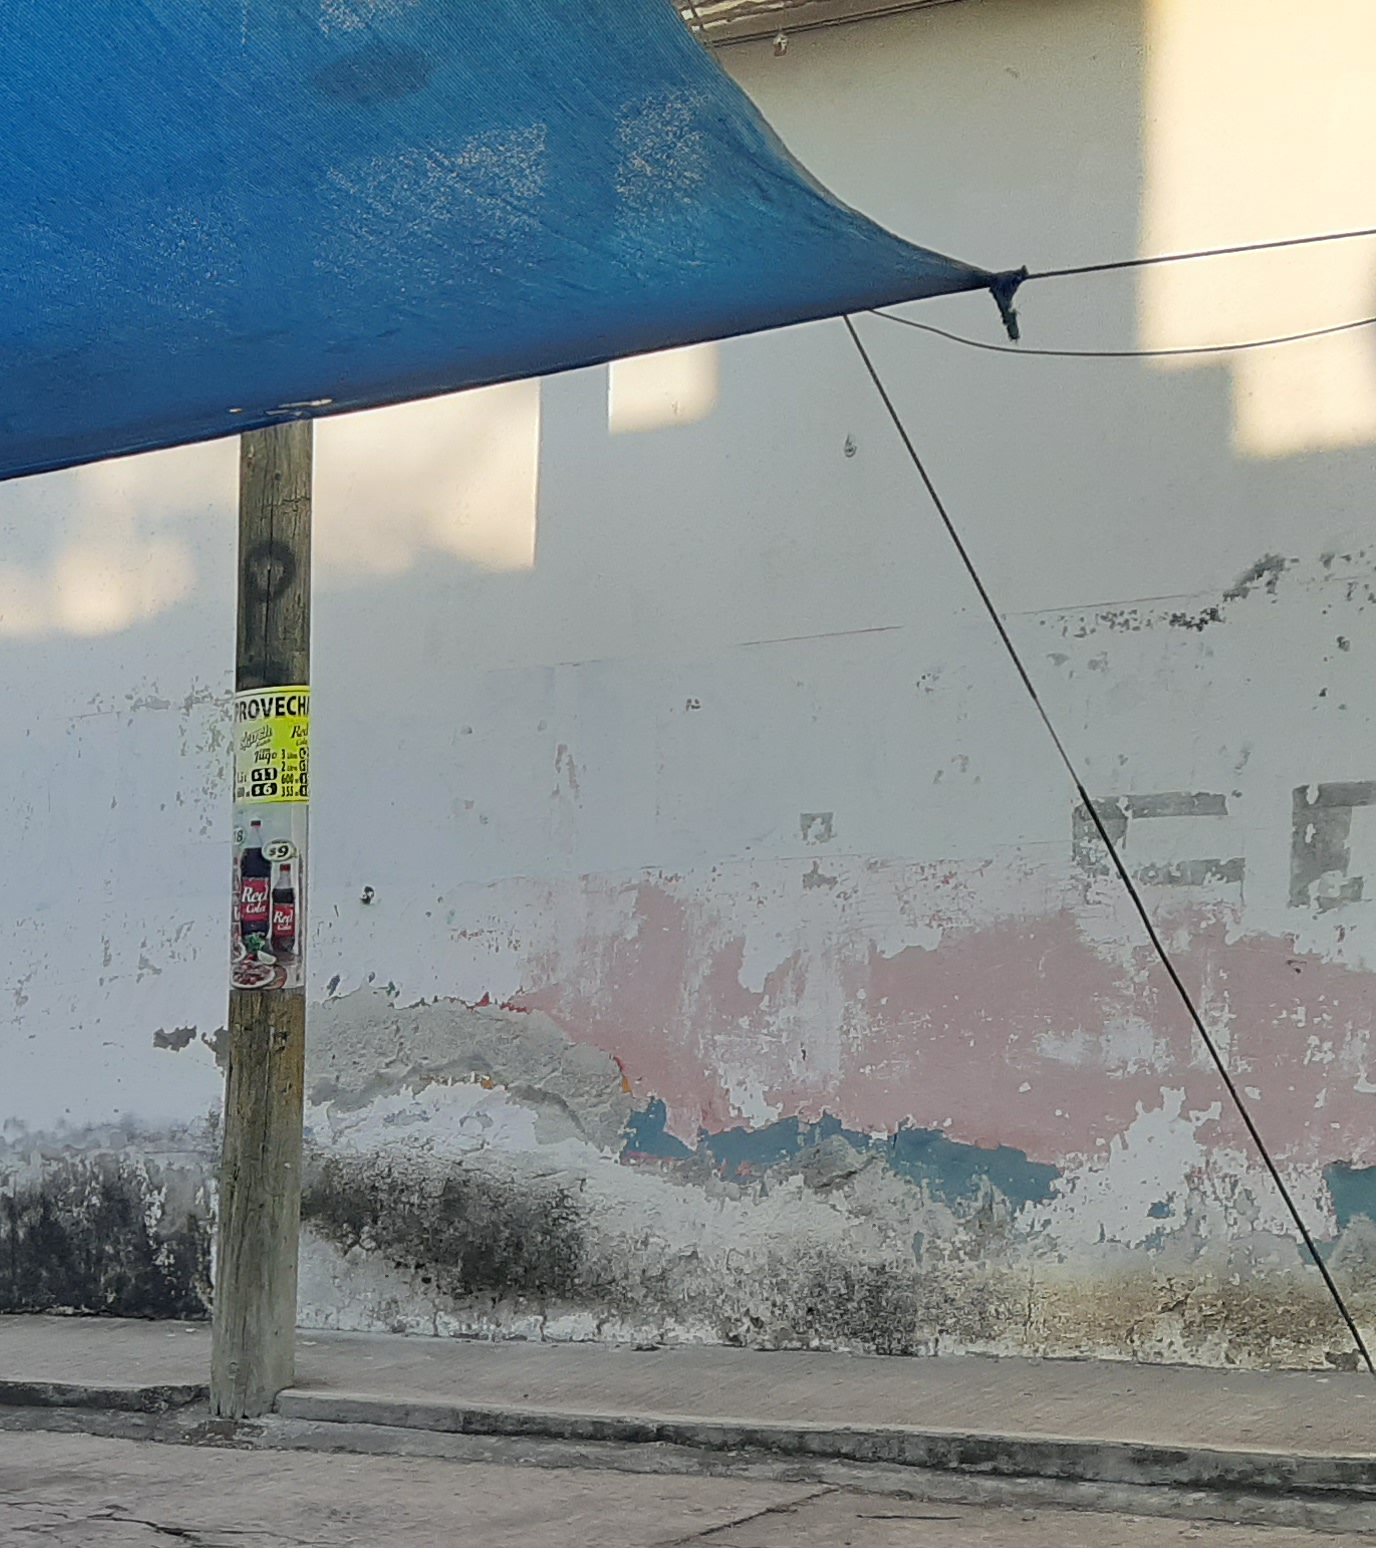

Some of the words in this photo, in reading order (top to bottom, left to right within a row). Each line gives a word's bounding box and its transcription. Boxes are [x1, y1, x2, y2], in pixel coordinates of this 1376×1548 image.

[269, 845, 289, 858] $9
[241, 881, 269, 903] Red
[246, 902, 267, 914] Cola
[274, 909, 294, 924] Red
